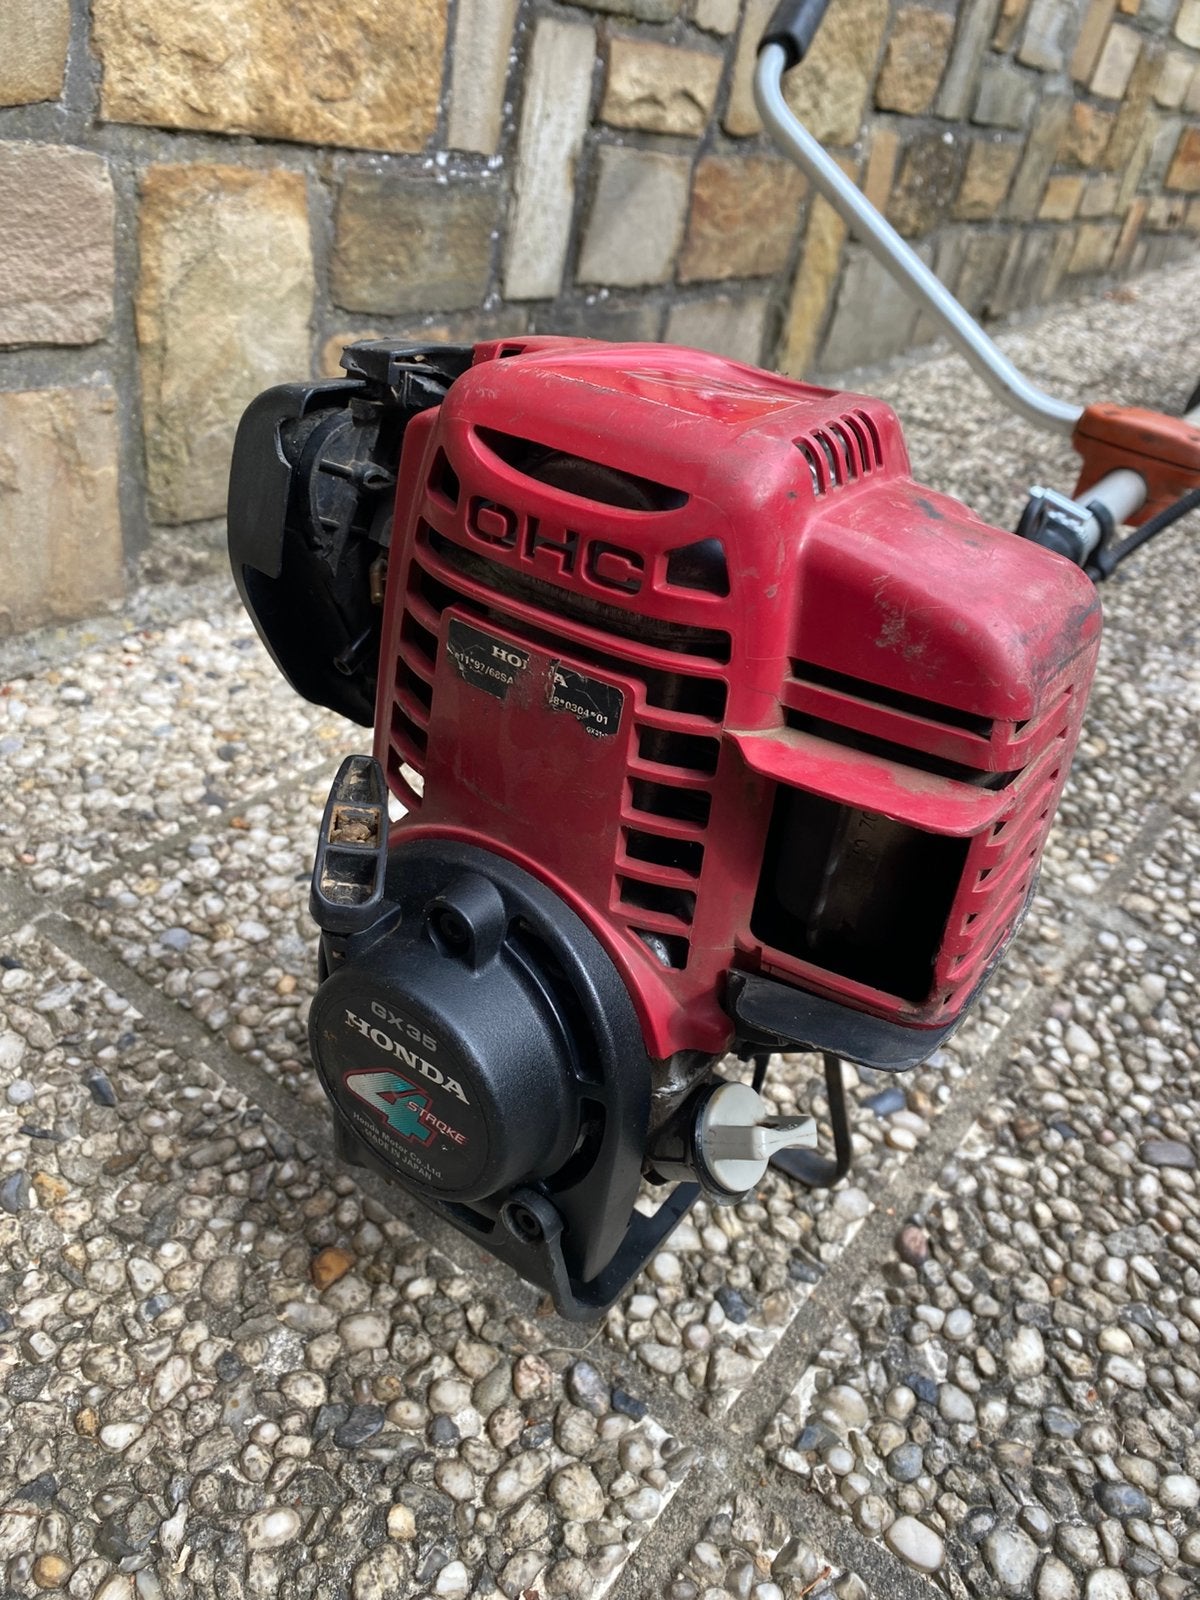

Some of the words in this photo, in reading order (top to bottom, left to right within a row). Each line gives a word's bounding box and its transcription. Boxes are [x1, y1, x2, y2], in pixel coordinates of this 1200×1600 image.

[466, 495, 645, 597] OHC
[491, 645, 568, 688] HOA
[371, 1000, 438, 1053] GX35
[345, 1009, 470, 1105] HONDA
[344, 1068, 435, 1147] 4
[353, 1112, 379, 1134] Honda
[382, 1131, 408, 1154] Motor
[407, 1101, 468, 1145] STROKE
[364, 1128, 390, 1151] MADE
[401, 1155, 433, 1181] JAPAN
